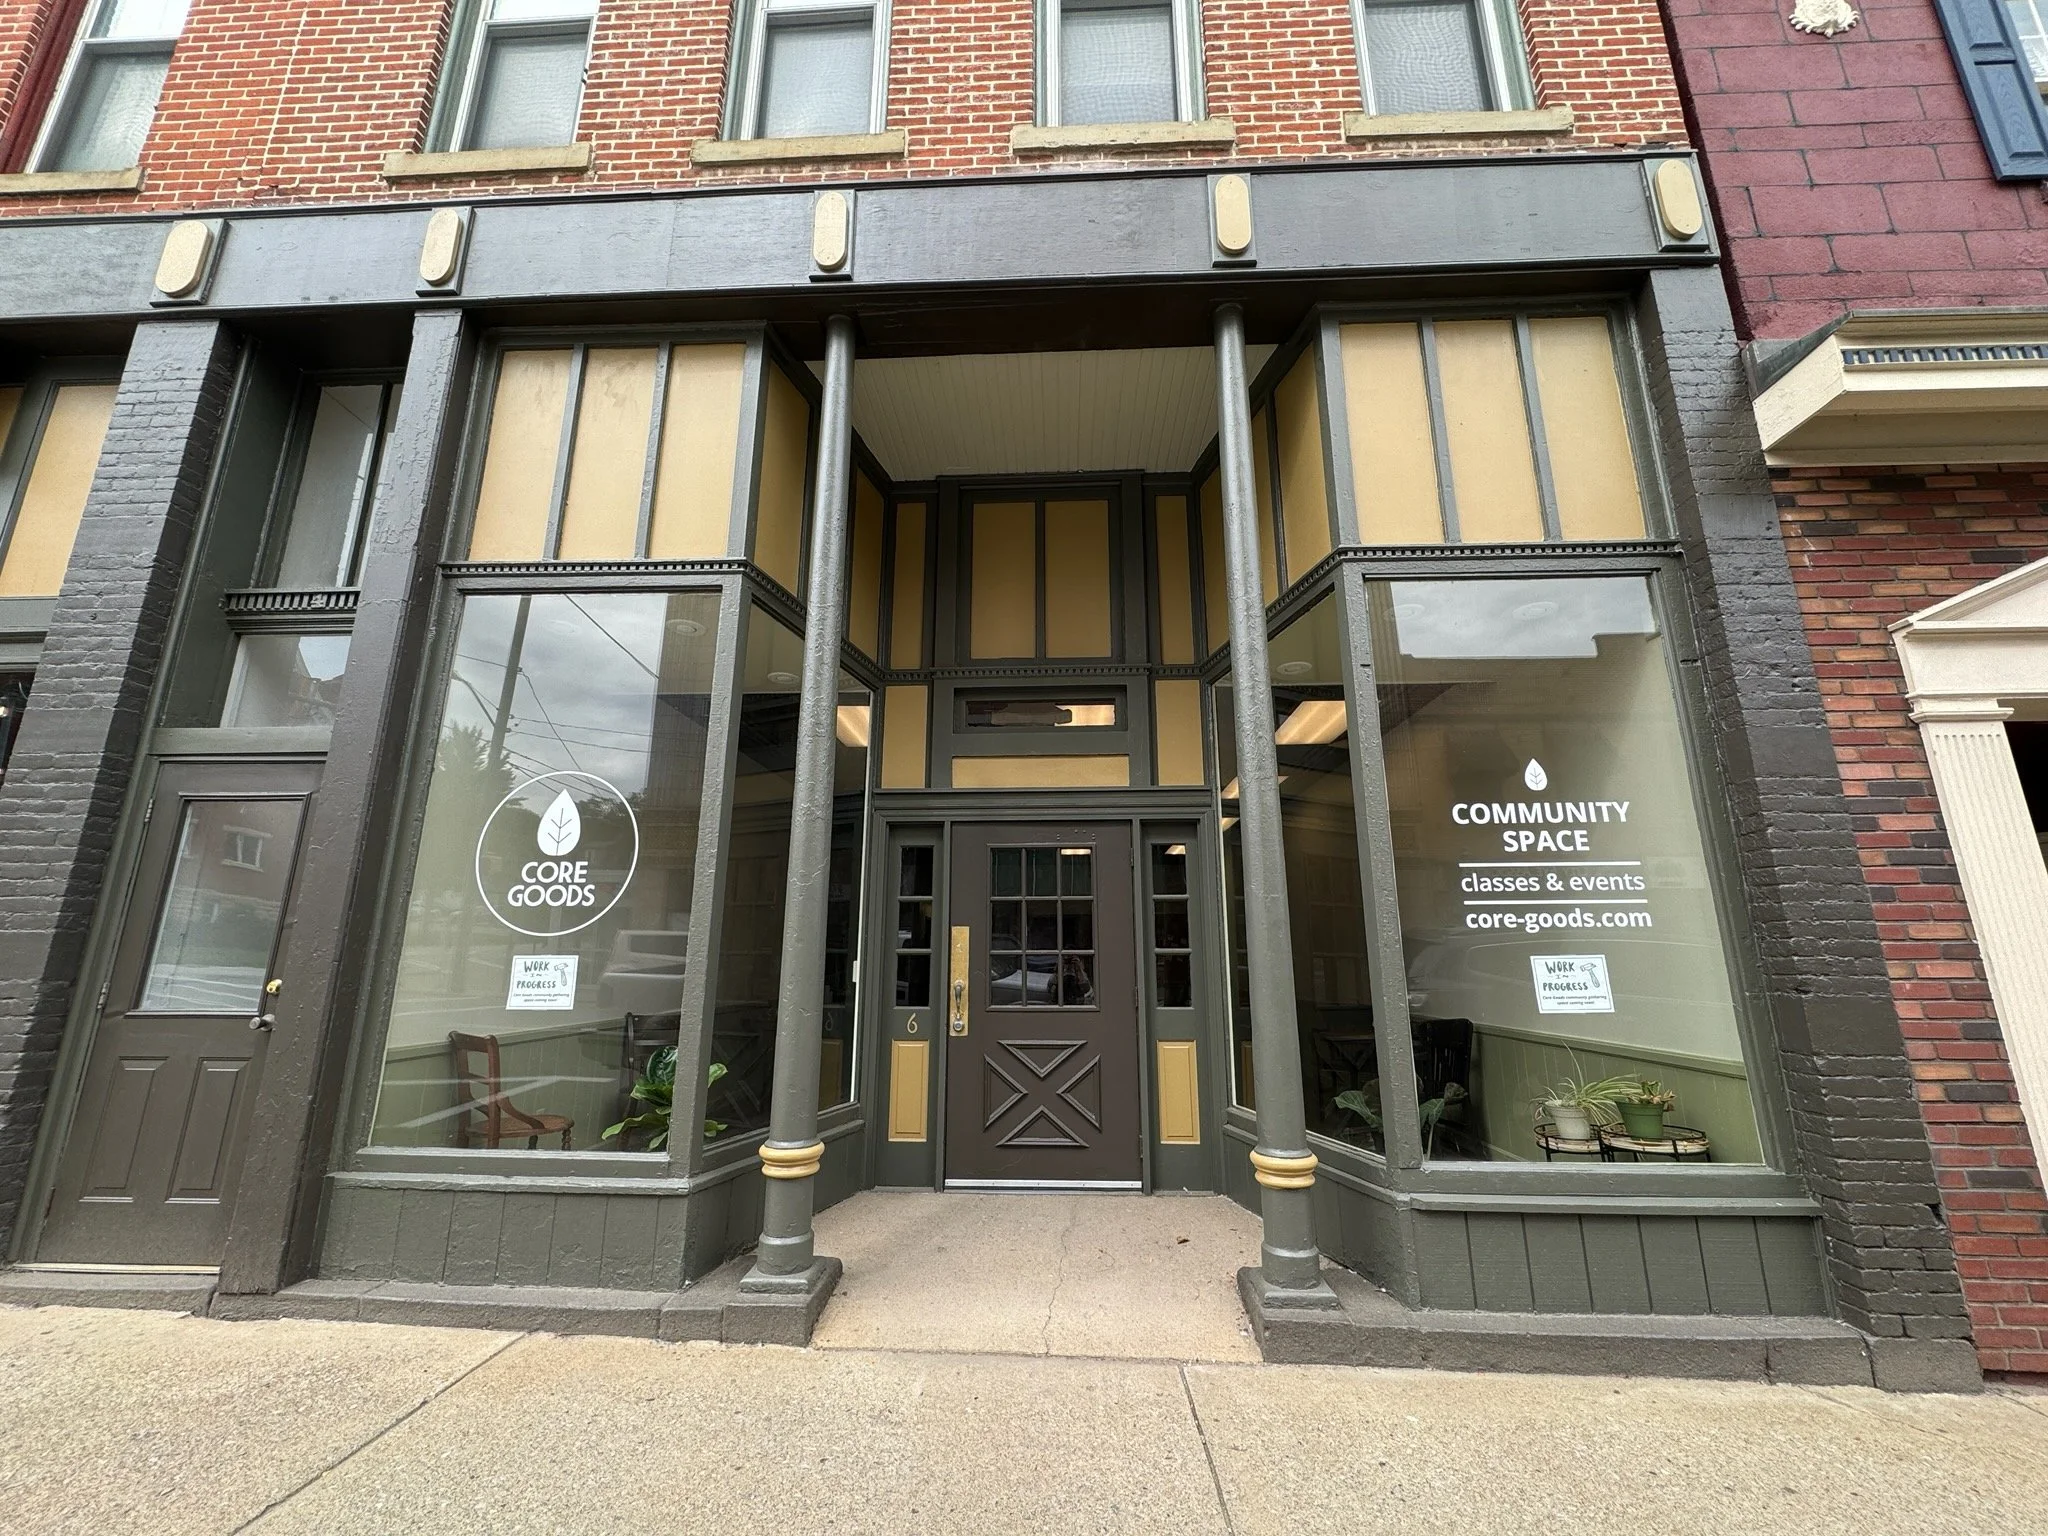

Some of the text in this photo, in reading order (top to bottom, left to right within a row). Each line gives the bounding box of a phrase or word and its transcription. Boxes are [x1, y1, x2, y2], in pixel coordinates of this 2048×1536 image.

[1452, 801, 1630, 825] COMMUNITY
[1502, 829, 1591, 852] SPACE
[521, 861, 589, 884] CORE
[1461, 872, 1646, 892] classes & events
[507, 884, 596, 907] GOODS
[1465, 907, 1653, 934] core-goods.com
[524, 960, 550, 973] WORK
[1544, 960, 1575, 974] WORK
[516, 980, 556, 989] PROGRESS
[1542, 982, 1588, 992] PROGRESS
[907, 1012, 918, 1034] 6
